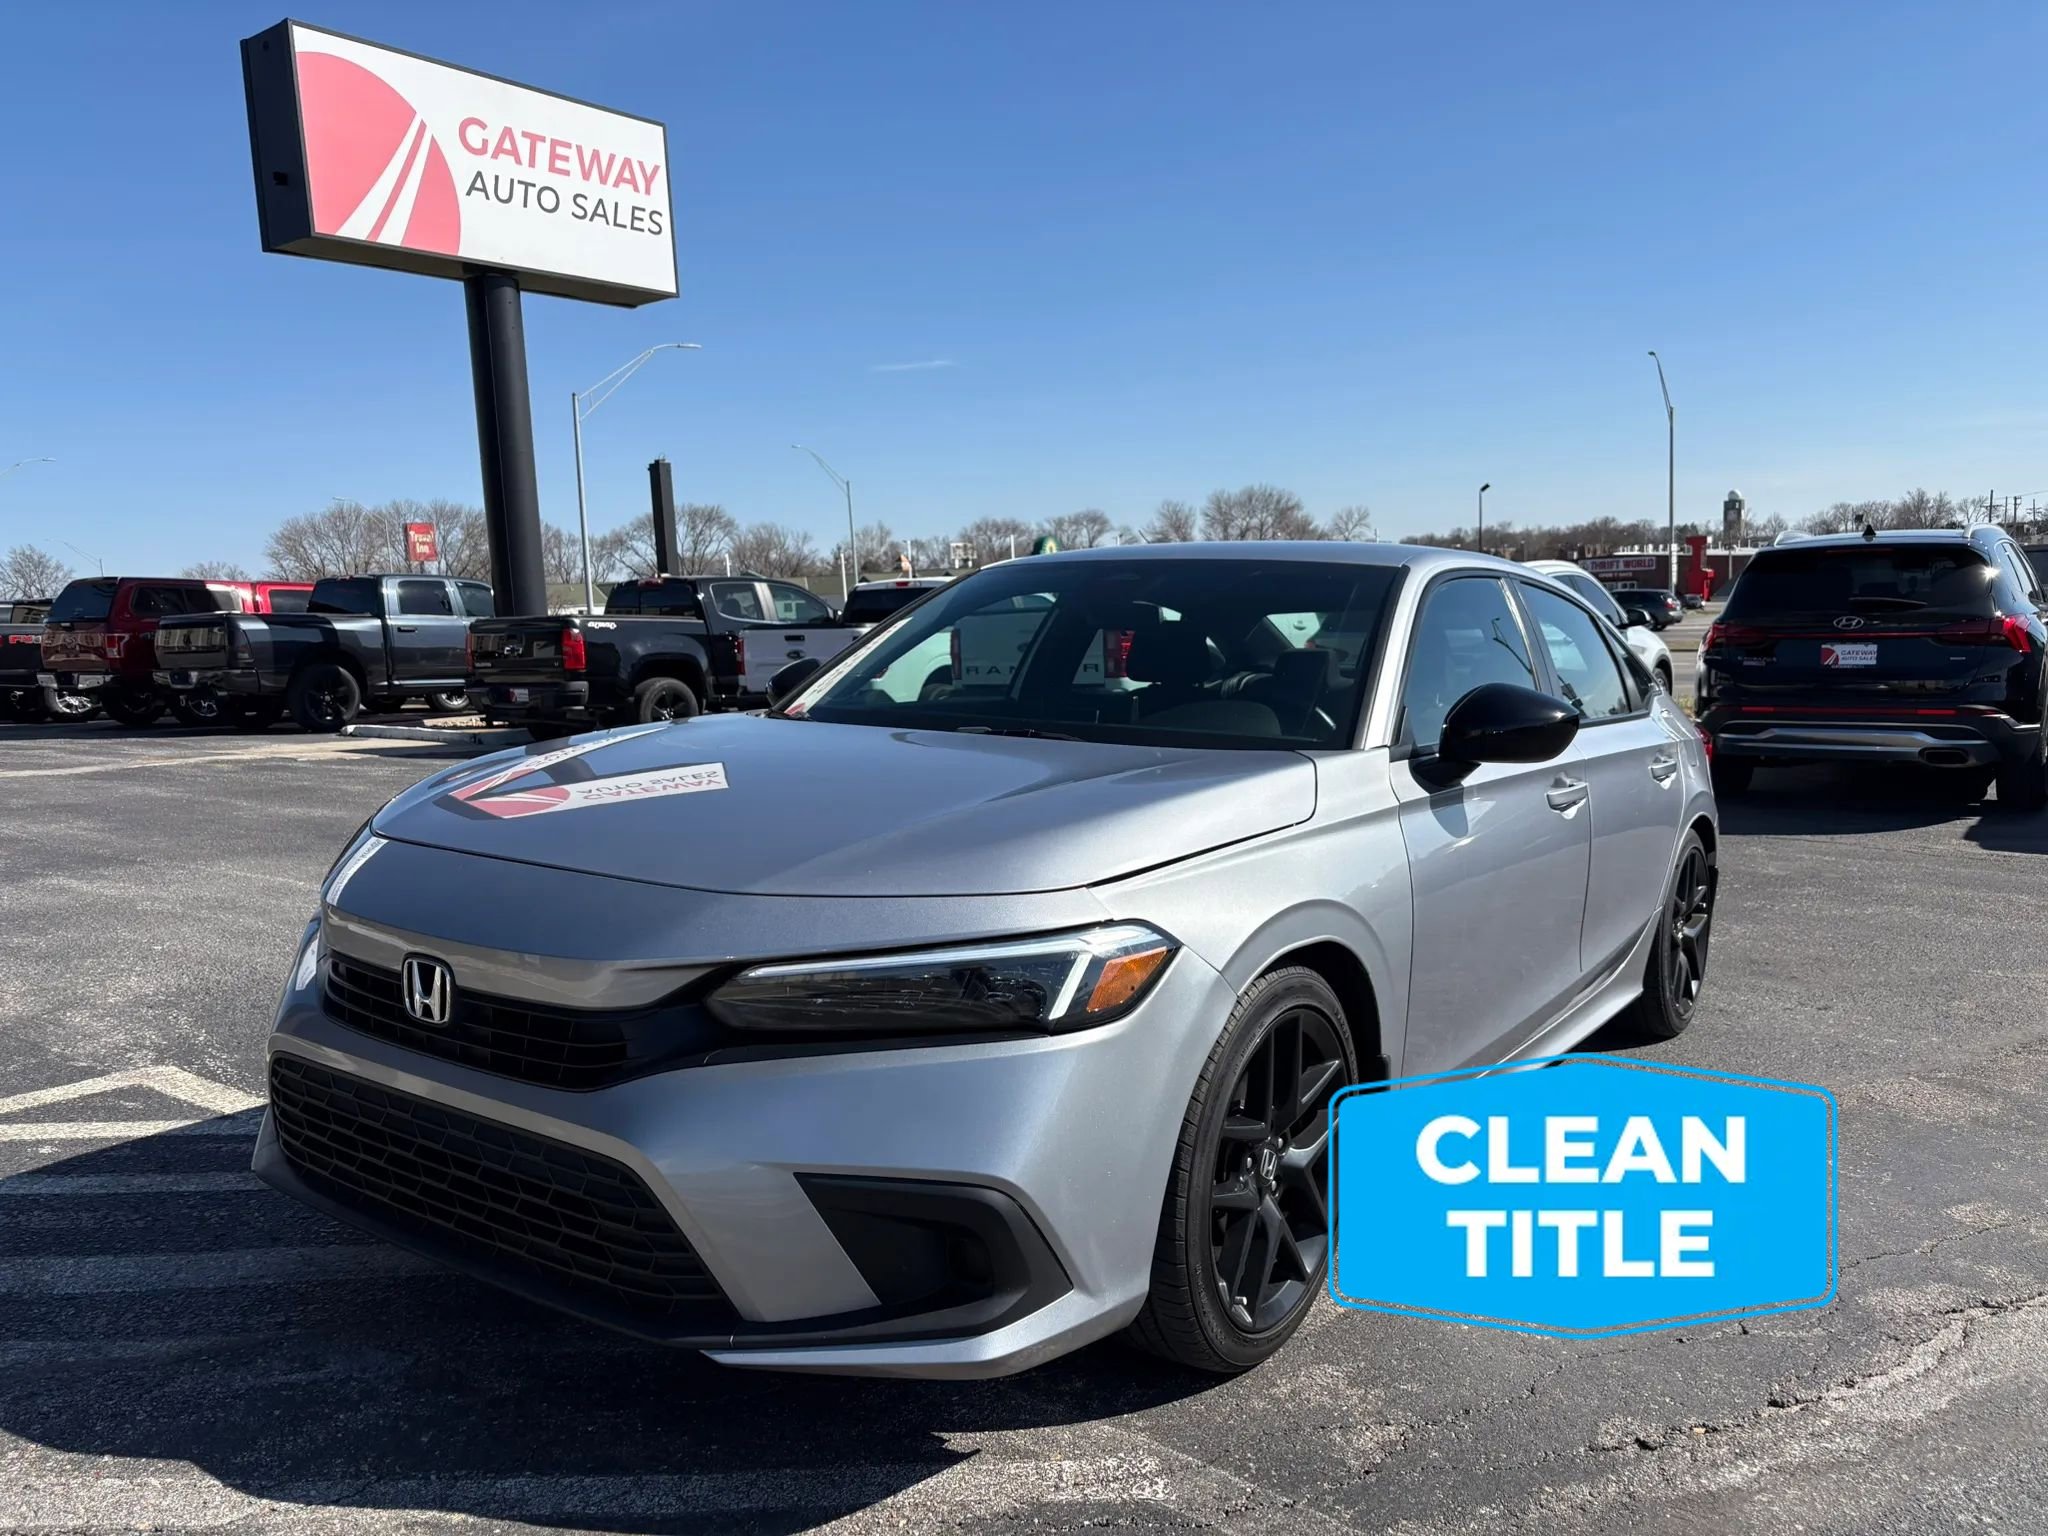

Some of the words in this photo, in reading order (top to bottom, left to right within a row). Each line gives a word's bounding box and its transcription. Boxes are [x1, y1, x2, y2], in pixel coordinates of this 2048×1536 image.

[458, 117, 661, 196] GATEWAY
[465, 170, 560, 214] AUTO
[571, 193, 663, 236] SALES
[1623, 558, 1653, 569] WORLD
